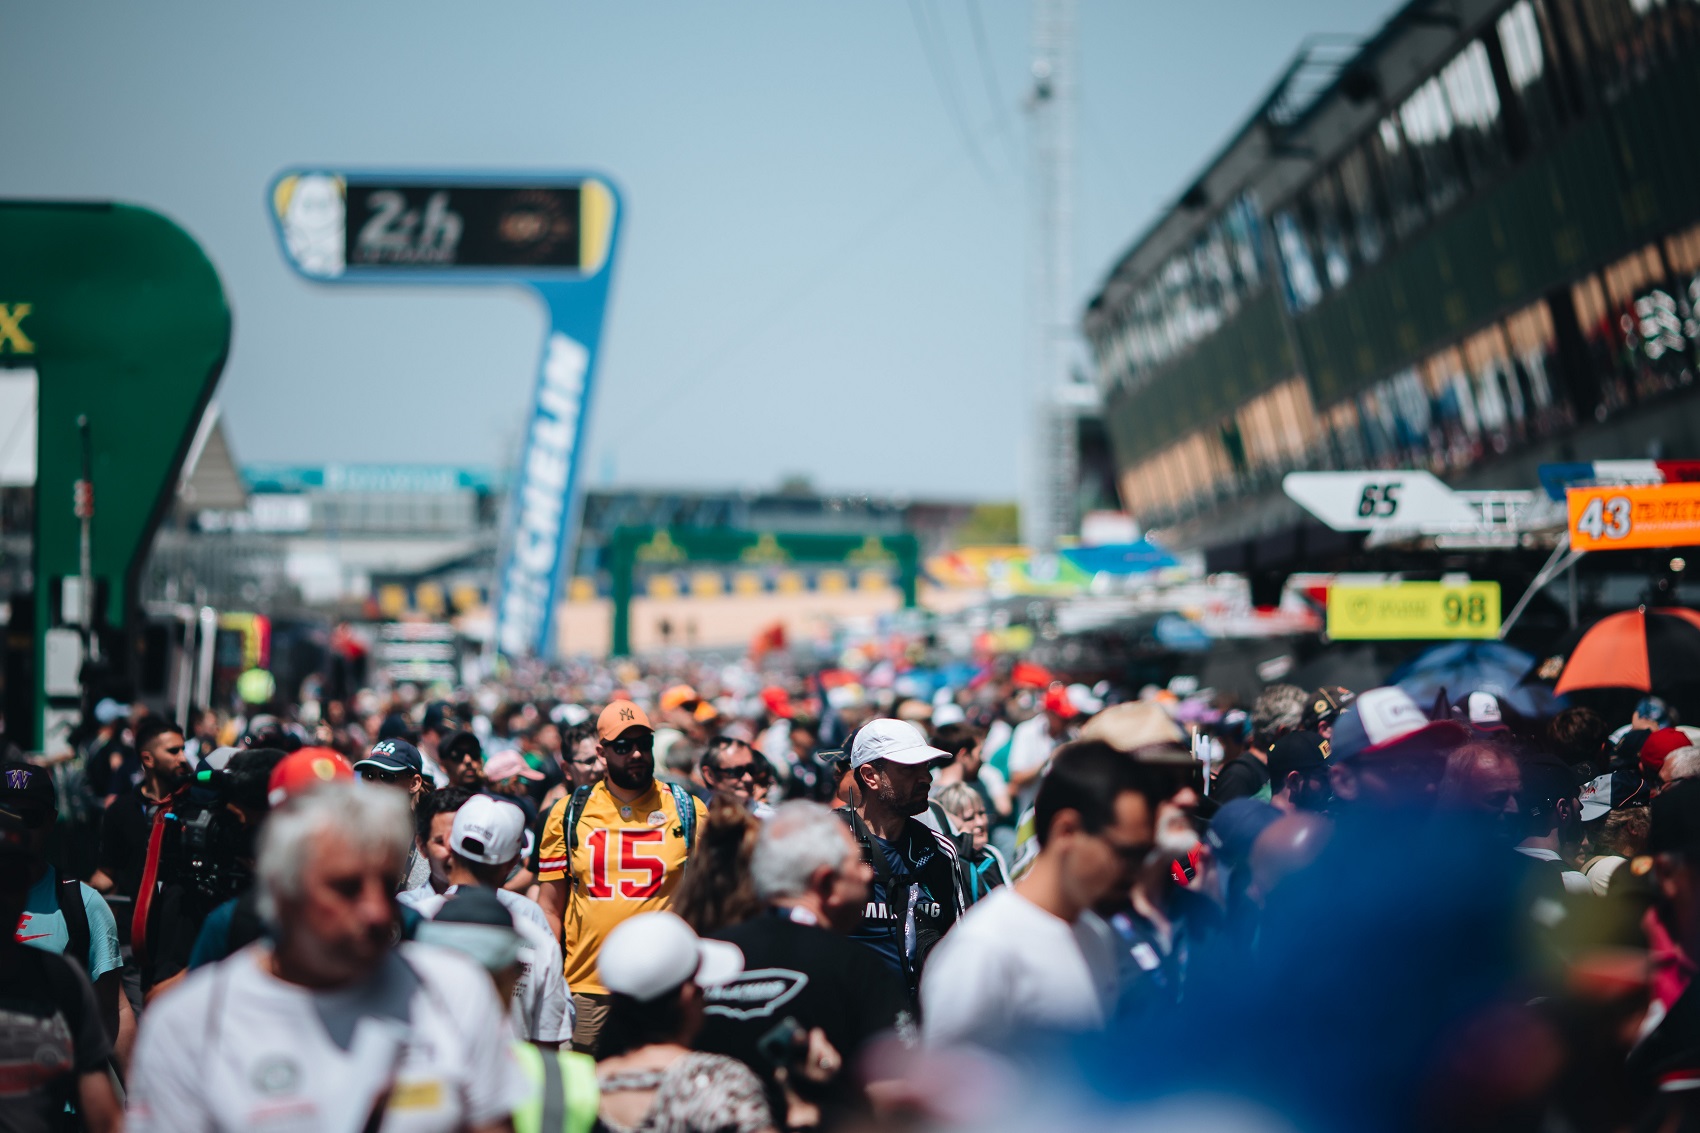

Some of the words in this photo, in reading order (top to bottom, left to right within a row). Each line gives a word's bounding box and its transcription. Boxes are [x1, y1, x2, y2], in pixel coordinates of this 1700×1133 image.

[1358, 483, 1403, 517] 65
[1577, 497, 1632, 540] 43
[1443, 594, 1486, 625] 98
[5, 769, 32, 790] W
[584, 827, 667, 901] 15
